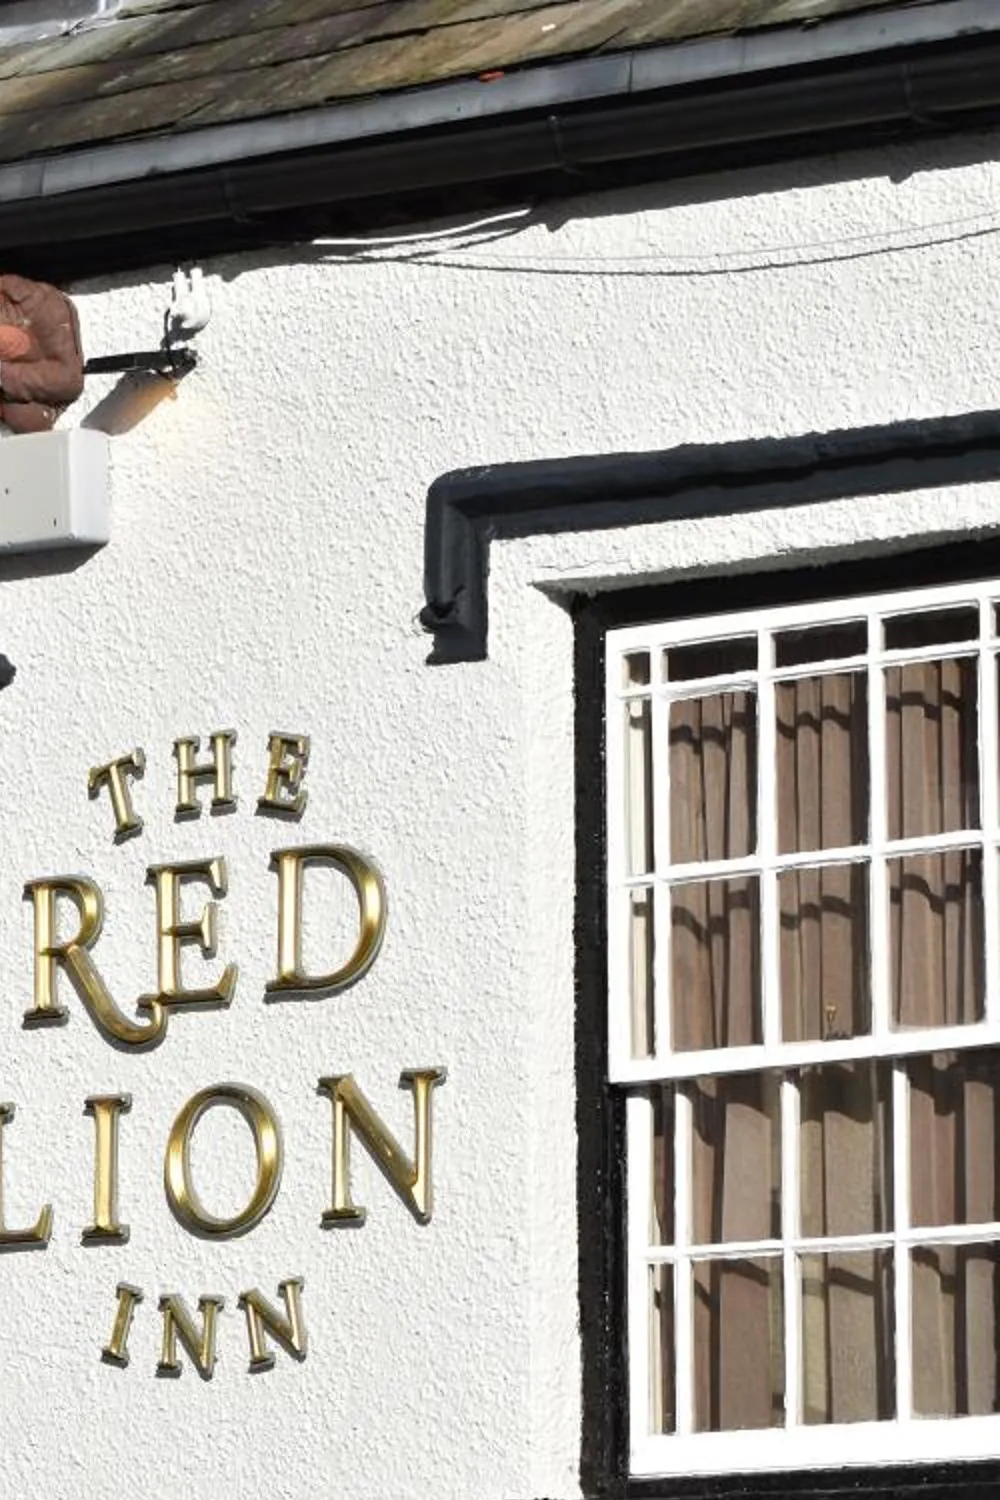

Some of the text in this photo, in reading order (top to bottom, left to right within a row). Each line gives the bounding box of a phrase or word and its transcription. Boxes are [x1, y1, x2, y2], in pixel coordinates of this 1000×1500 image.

[87, 729, 310, 843] THE
[22, 843, 388, 1053] RED
[101, 1276, 307, 1379] INN
